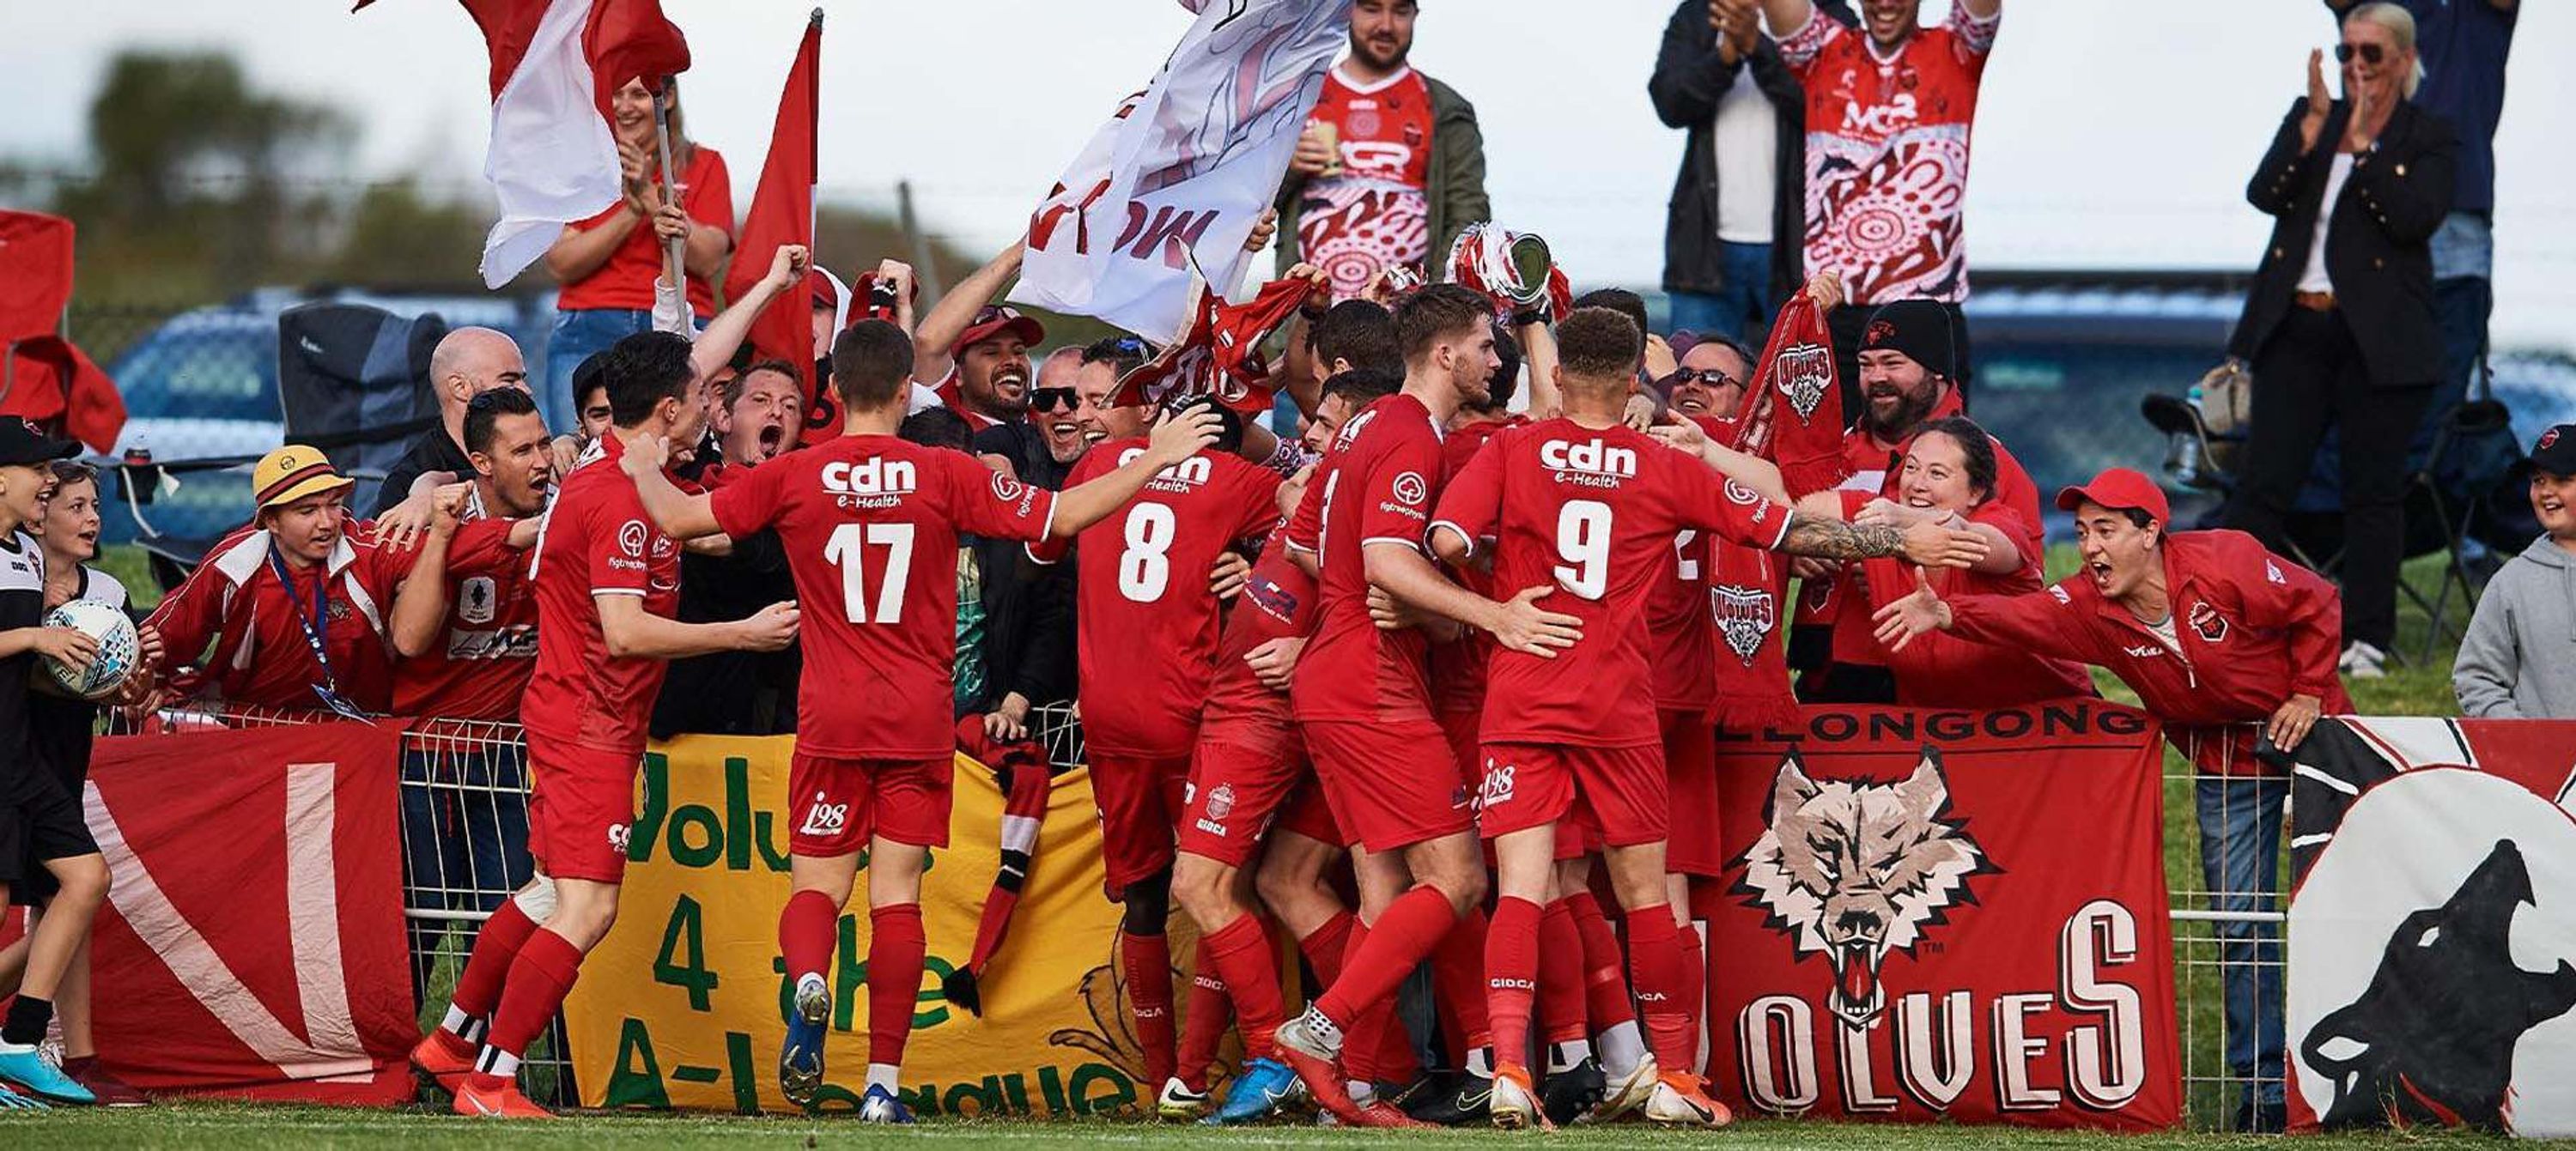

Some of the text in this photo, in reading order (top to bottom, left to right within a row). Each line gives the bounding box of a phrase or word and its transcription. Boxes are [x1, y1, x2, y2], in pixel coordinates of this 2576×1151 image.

[822, 456, 916, 492] cdn
[837, 494, 902, 508] e-Health
[1541, 438, 1637, 476] cdn
[1555, 471, 1620, 488] e-Health
[823, 523, 914, 624] 17
[1119, 502, 1176, 602] 8
[1552, 500, 1613, 600] 9
[653, 894, 718, 1011] 4
[1693, 899, 2145, 1113] OLVES
